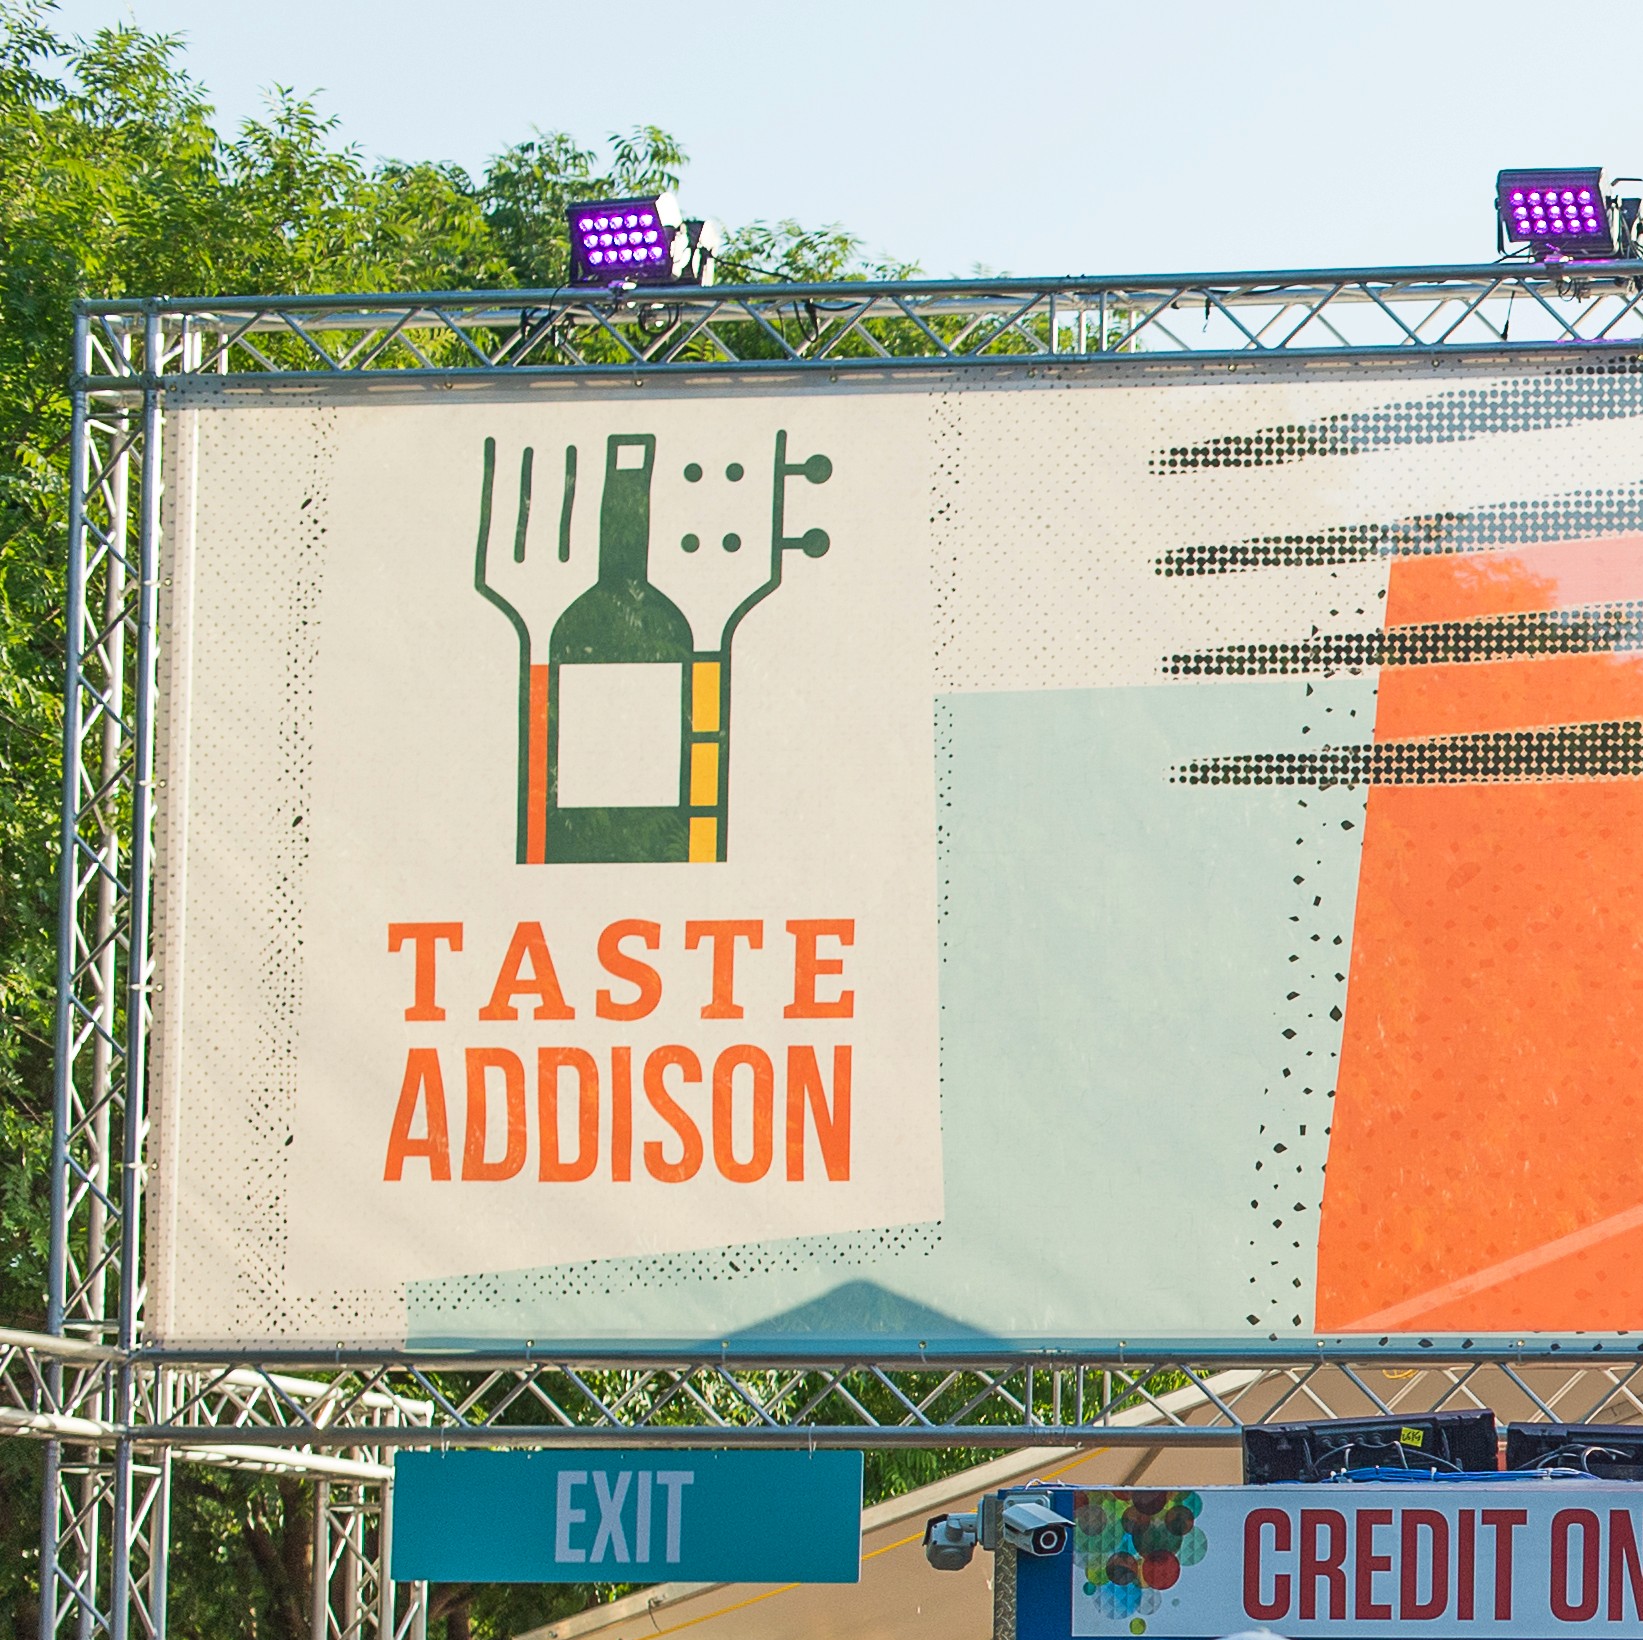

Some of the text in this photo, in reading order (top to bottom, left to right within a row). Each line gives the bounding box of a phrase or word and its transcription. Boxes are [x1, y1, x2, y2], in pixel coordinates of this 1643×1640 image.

[387, 919, 856, 1022] TASTE
[383, 1044, 852, 1183] ADDISON
[553, 1469, 695, 1564] EXIT
[1242, 1507, 1528, 1622] CREDIT
